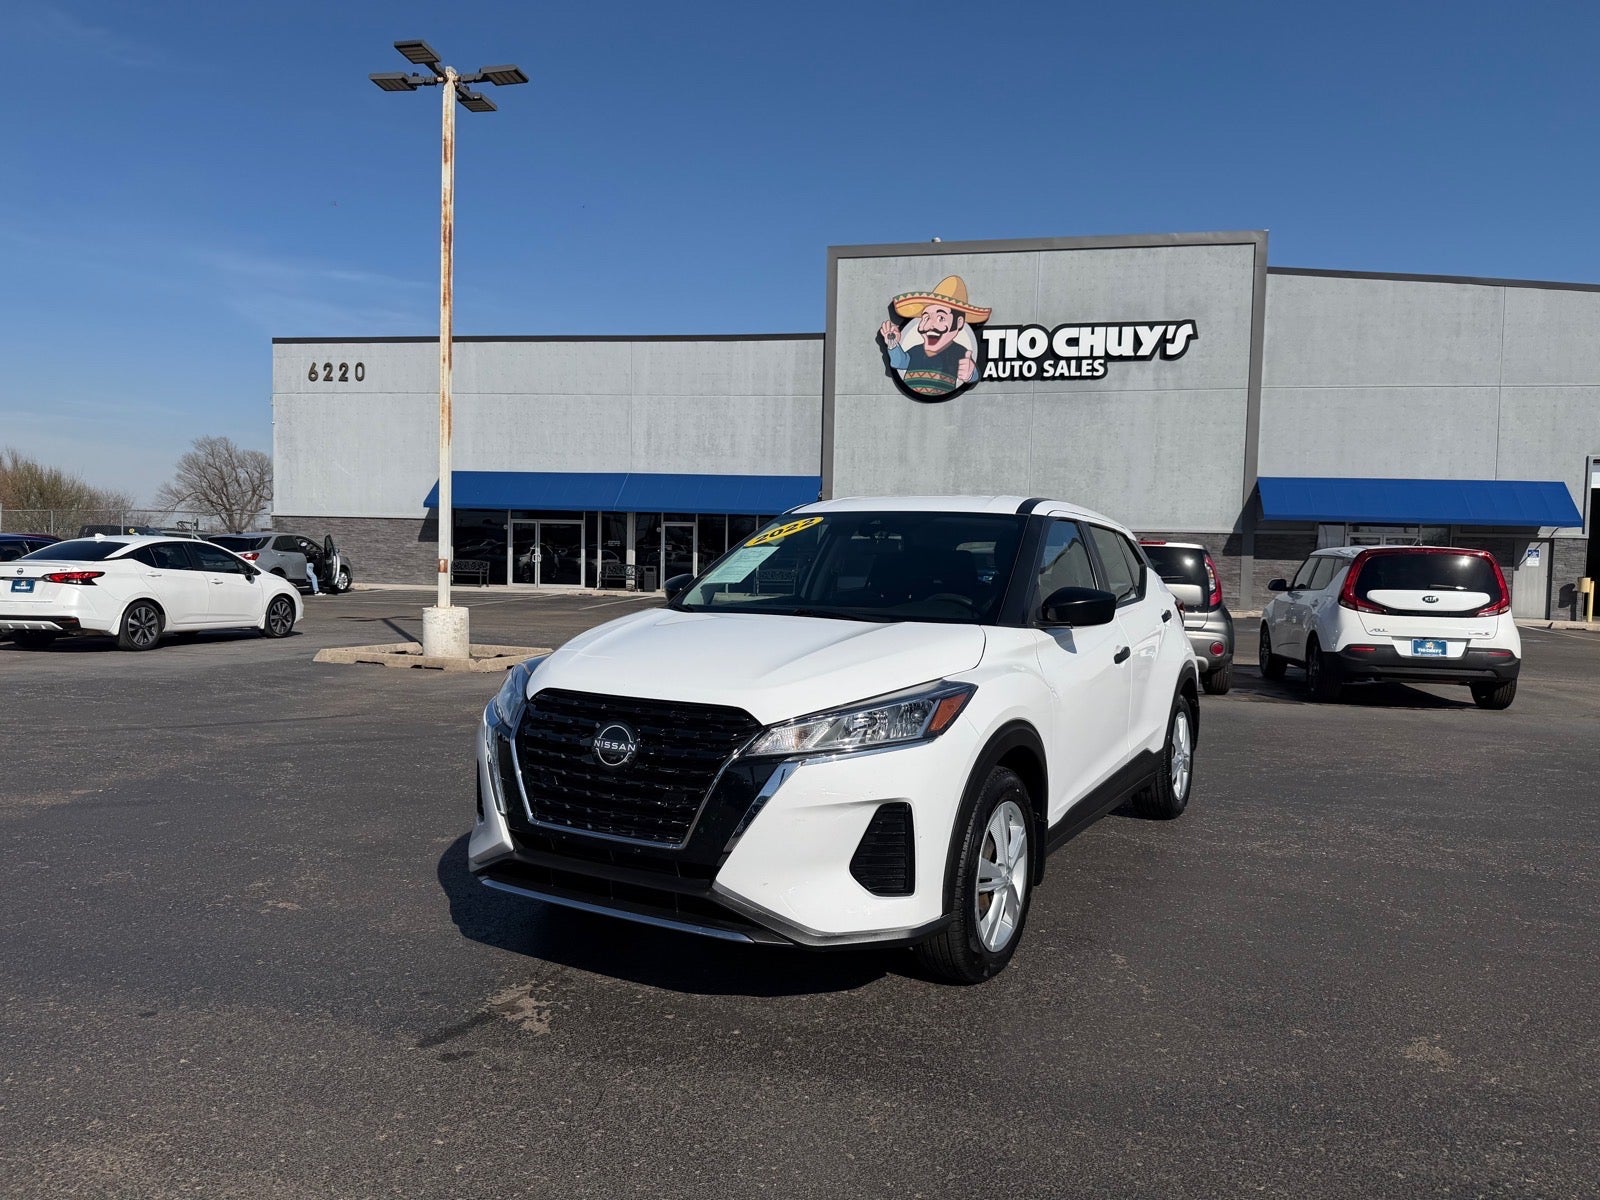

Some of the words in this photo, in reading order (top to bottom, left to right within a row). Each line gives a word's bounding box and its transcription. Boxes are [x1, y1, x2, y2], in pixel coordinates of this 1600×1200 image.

[982, 328, 1048, 359] TIO
[1052, 323, 1194, 357] CHUY'S
[308, 361, 365, 382] 6220
[983, 361, 1037, 378] AUTO
[1042, 359, 1105, 377] SALES
[752, 518, 816, 545] 2022
[593, 740, 636, 752] NISSAN
